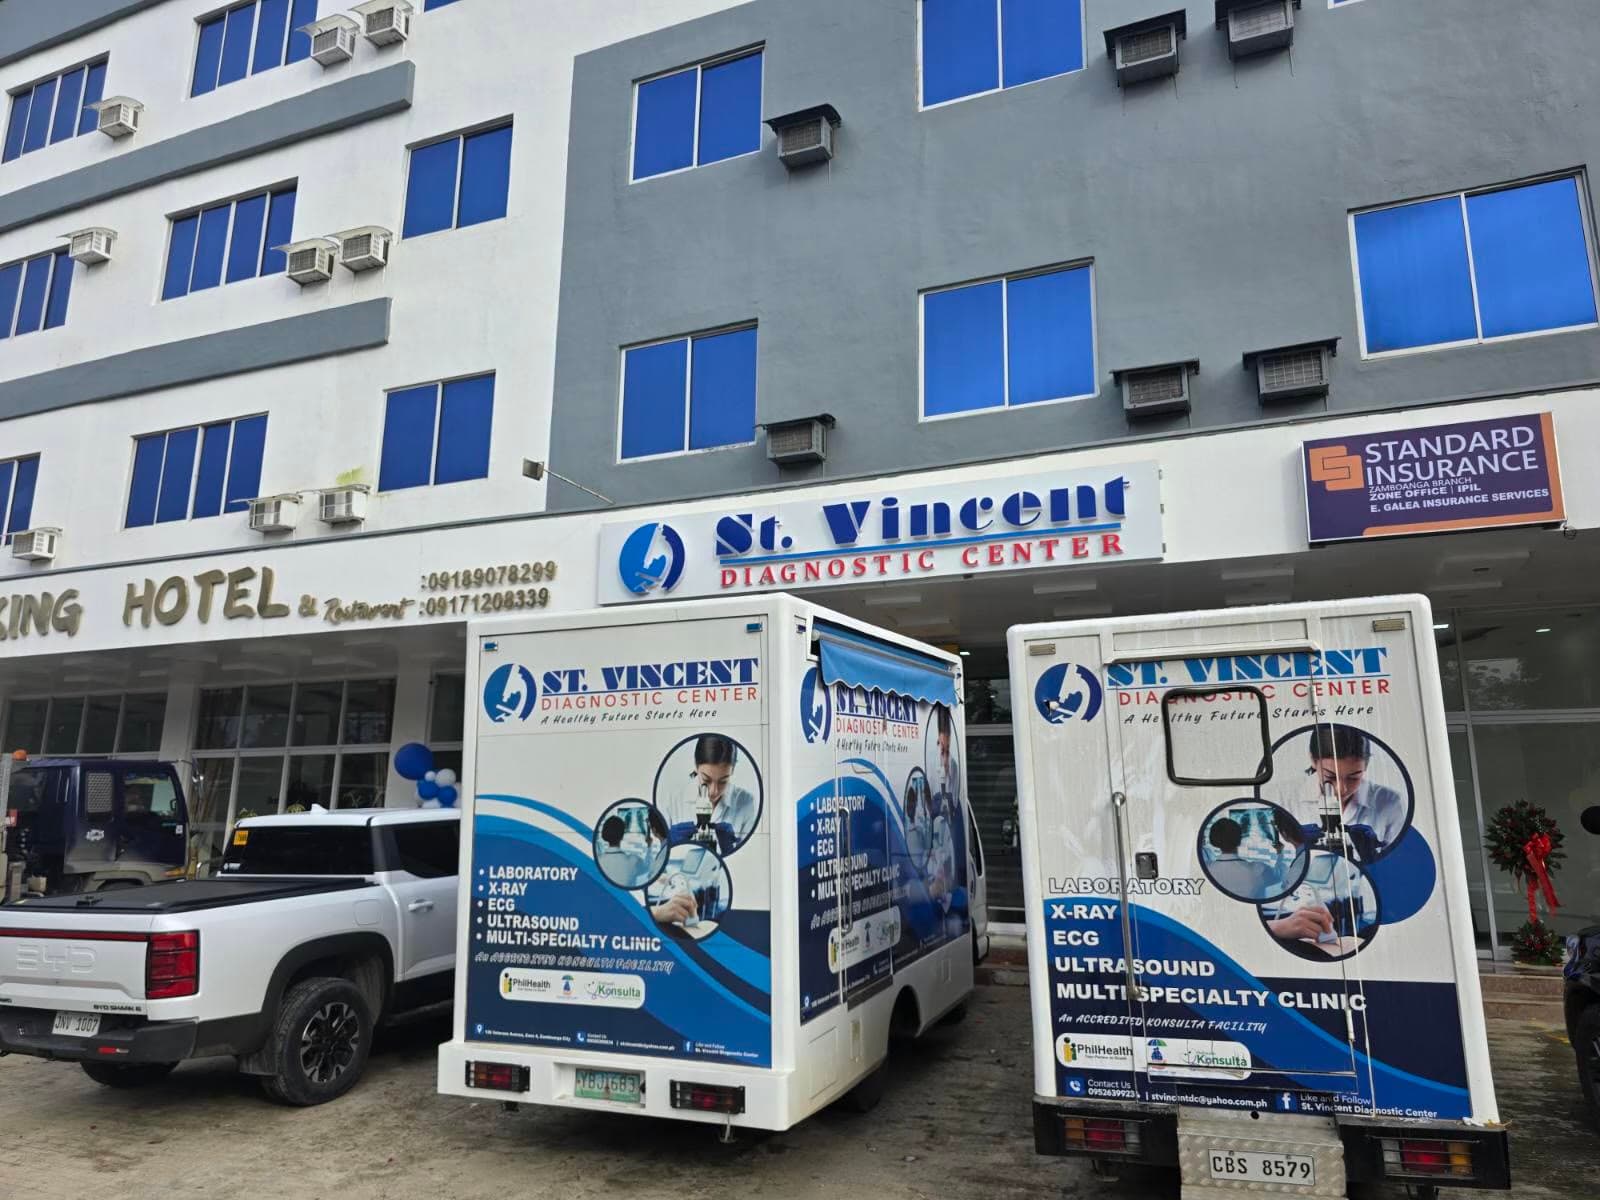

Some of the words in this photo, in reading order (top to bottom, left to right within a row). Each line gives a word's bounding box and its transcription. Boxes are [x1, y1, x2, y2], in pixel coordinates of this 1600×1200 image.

[1365, 426, 1535, 464] STANDARD
[1366, 449, 1539, 486] INSURANCE
[1369, 481, 1429, 493] ZAMBOANGA
[1432, 477, 1472, 487] BRANCH
[1370, 490, 1402, 501] ZONE
[1405, 486, 1447, 498] OFFICE
[1457, 483, 1482, 493] IPIL
[1370, 504, 1381, 513] E.
[1384, 501, 1420, 512] GALEA
[1423, 494, 1489, 508] INSURANCE
[1491, 488, 1550, 502] SERVICES
[715, 512, 793, 557] St.
[823, 475, 1131, 546] Vincent
[720, 549, 935, 588] DIAGNOSTIC
[962, 533, 1124, 568] CENTER
[122, 566, 289, 628] HOTEL
[542, 668, 589, 694] ST.
[601, 657, 759, 691] VINCENT
[1107, 661, 1168, 687] ST.
[1184, 647, 1388, 683] VINCENT
[1293, 678, 1390, 698] CENTER
[541, 692, 664, 711] DIAGNOSTIC
[677, 686, 757, 703] CENTER
[540, 715, 550, 725] A
[553, 712, 597, 726] Healthy
[601, 711, 640, 722] Future
[645, 708, 684, 720] Starts
[689, 707, 718, 718] Here
[1124, 714, 1133, 724] A
[1142, 711, 1203, 725] Helthy
[1335, 705, 1375, 716] Here
[816, 817, 841, 836] X-RAY
[817, 838, 834, 857] ECG
[489, 866, 578, 881] LABORATORY
[488, 882, 528, 896] X-RAY
[1048, 877, 1205, 895] LABORATORY
[488, 898, 515, 911] ECG
[1050, 904, 1118, 920] X-RAY
[487, 914, 579, 931] ULTRASOUND
[486, 930, 608, 949] MULTI-SPECIALTY
[612, 935, 661, 951] CLINIC
[1053, 930, 1099, 946] ECG
[1055, 956, 1215, 976] ULTRASOUND
[512, 978, 551, 989] PhilHealth
[598, 984, 641, 998] Konsulta
[1056, 982, 1270, 1007] MULTISPECIALTY
[1278, 991, 1367, 1011] CLINIC
[1059, 1013, 1073, 1023] An
[1076, 1014, 1142, 1026] ACCREDITED
[1146, 1017, 1205, 1029] KONSULTA
[1208, 1020, 1268, 1034] FACILITY
[1077, 1044, 1133, 1056] PhilHealth
[1196, 1054, 1247, 1067] Konsulta
[1087, 1079, 1118, 1088] Contact
[1121, 1081, 1131, 1089] Us
[1088, 1088, 1141, 1099] 0952639923
[1300, 1094, 1318, 1102] Like
[1342, 1095, 1371, 1105] Follow
[1301, 1102, 1313, 1111] St.
[1354, 1105, 1403, 1116] Diagnostic
[1405, 1108, 1438, 1118] Center
[1212, 1156, 1248, 1174] CBS
[1262, 1160, 1311, 1179] 8579
